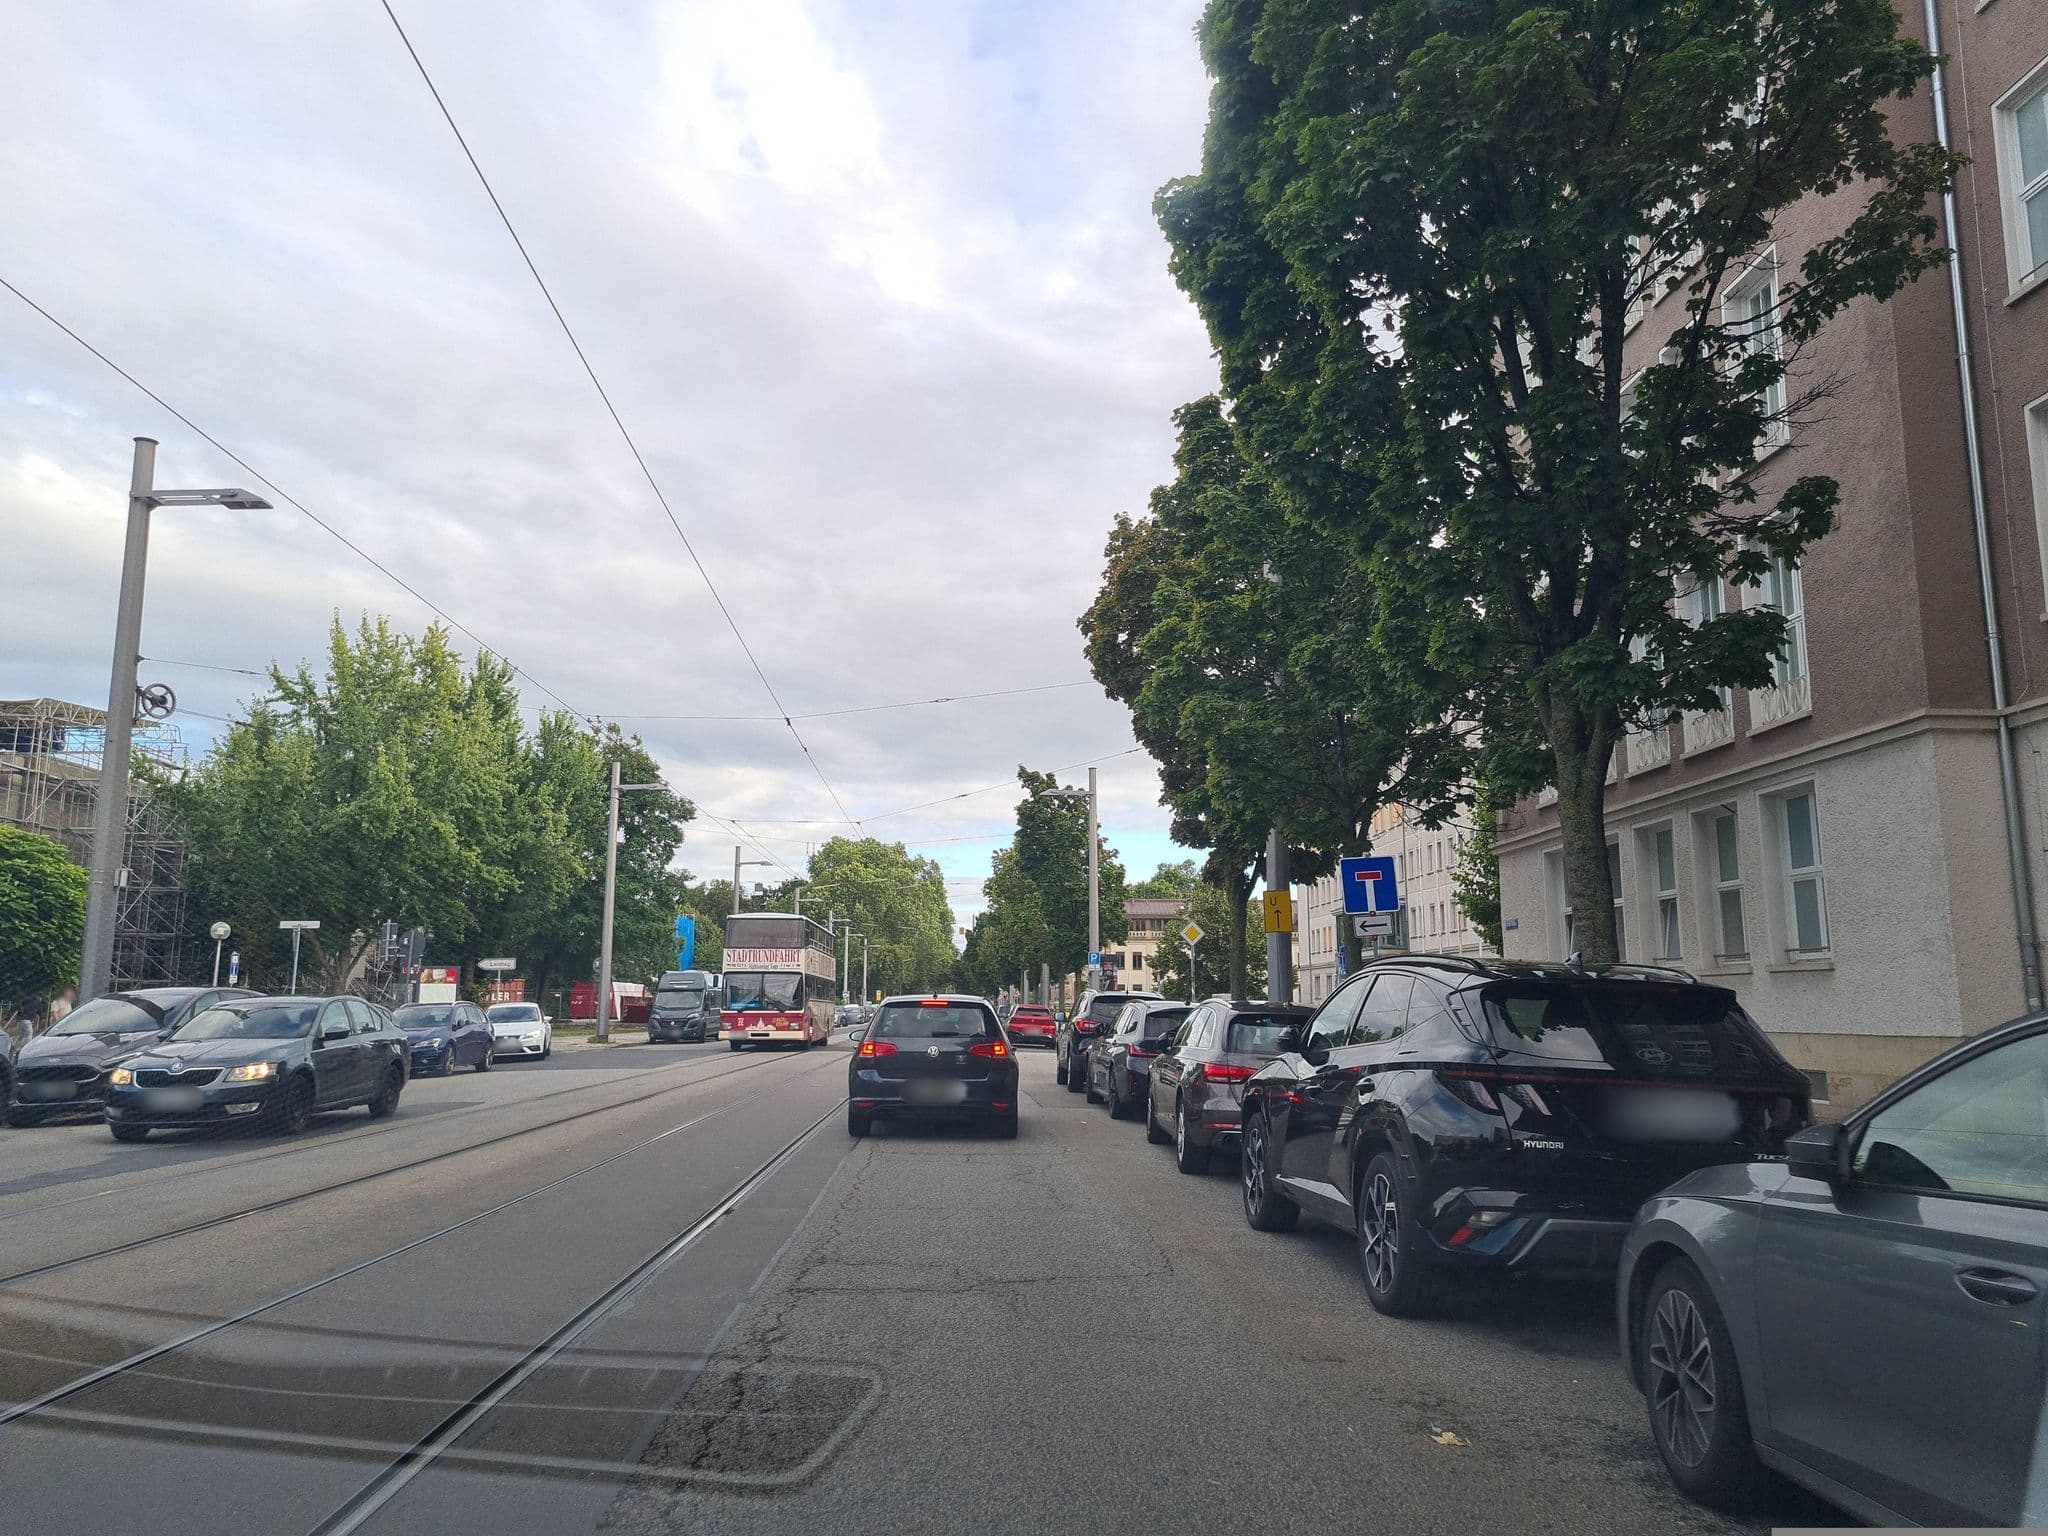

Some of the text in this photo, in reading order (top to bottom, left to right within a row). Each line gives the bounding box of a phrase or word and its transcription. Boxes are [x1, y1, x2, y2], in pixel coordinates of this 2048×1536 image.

[1269, 896, 1277, 907] U
[726, 949, 801, 963] STADTRUNDFAHRT
[1090, 953, 1098, 963] P
[1523, 1139, 1564, 1150] HYUNDAI
